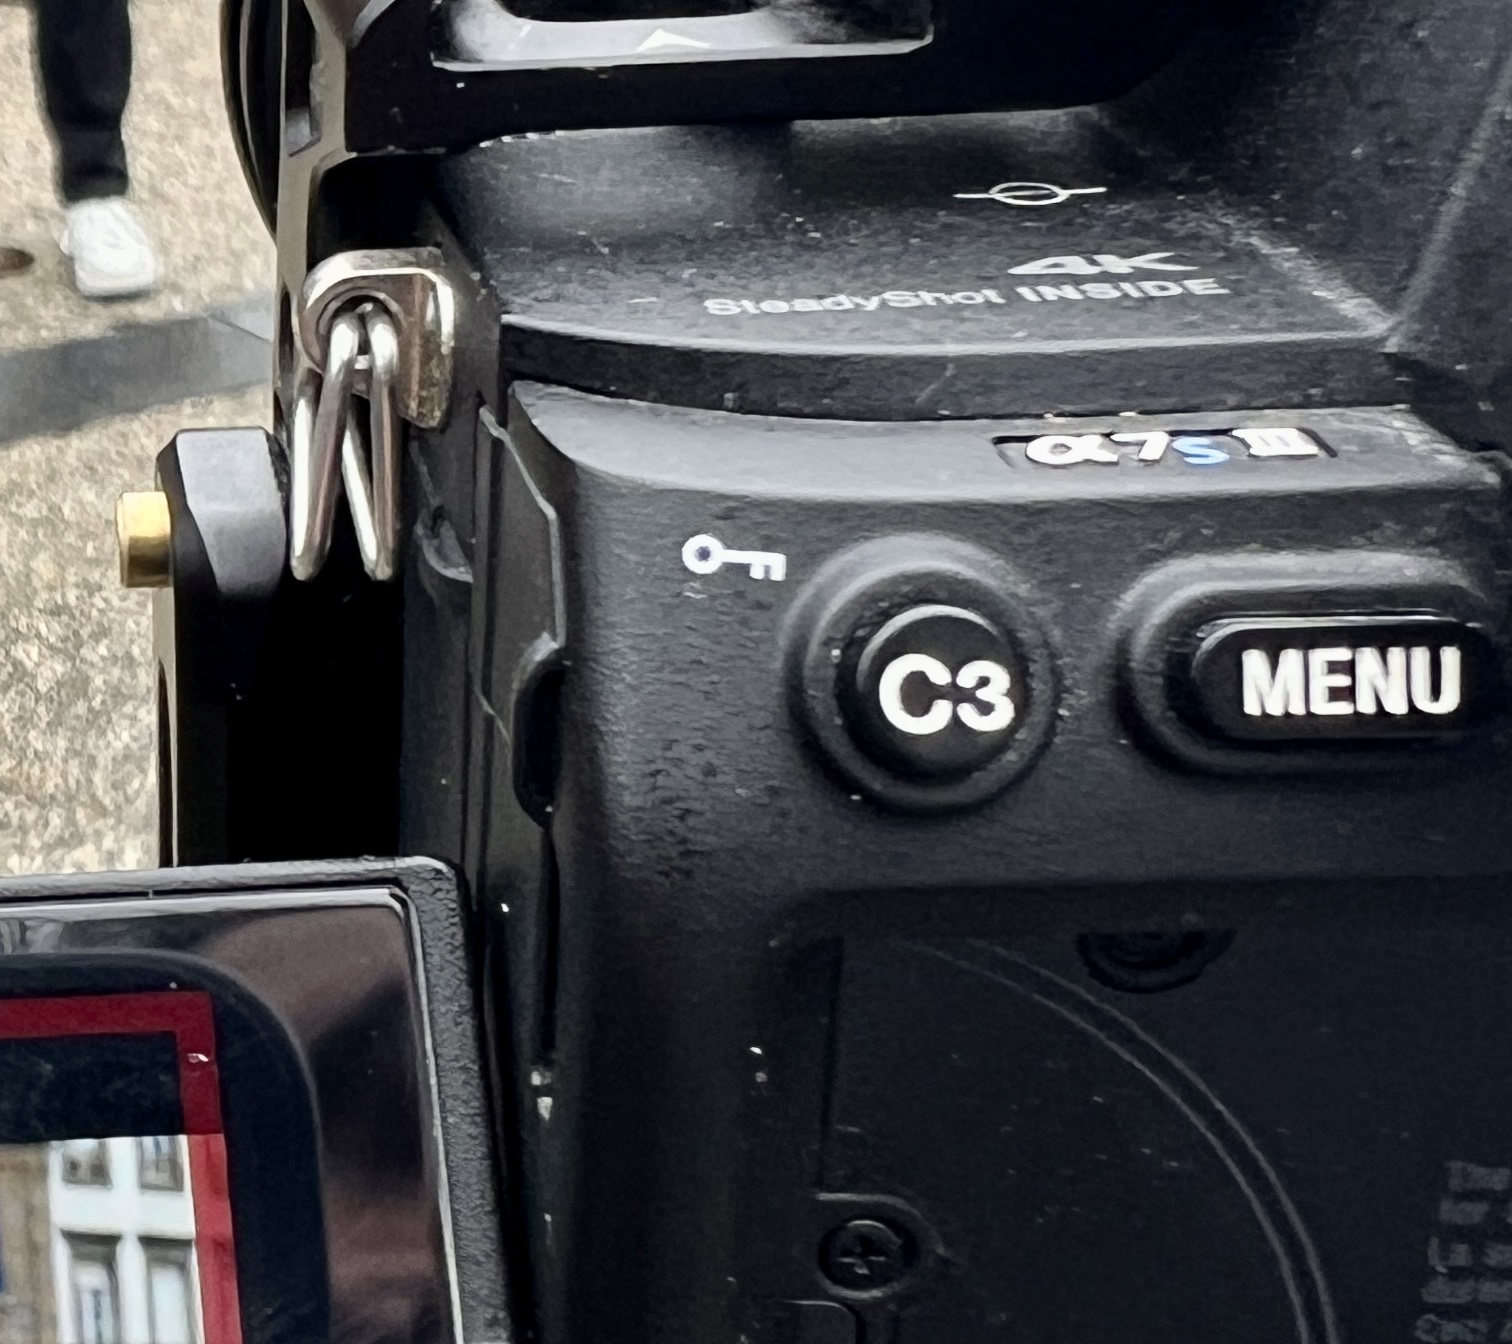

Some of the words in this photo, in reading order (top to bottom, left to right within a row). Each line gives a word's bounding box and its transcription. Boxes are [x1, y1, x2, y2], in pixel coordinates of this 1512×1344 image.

[1007, 252, 1199, 275] 4K
[703, 288, 1006, 317] SteadyShot
[1015, 277, 1231, 303] INSIDE
[879, 653, 1015, 734] C3
[1242, 646, 1462, 716] MENU
